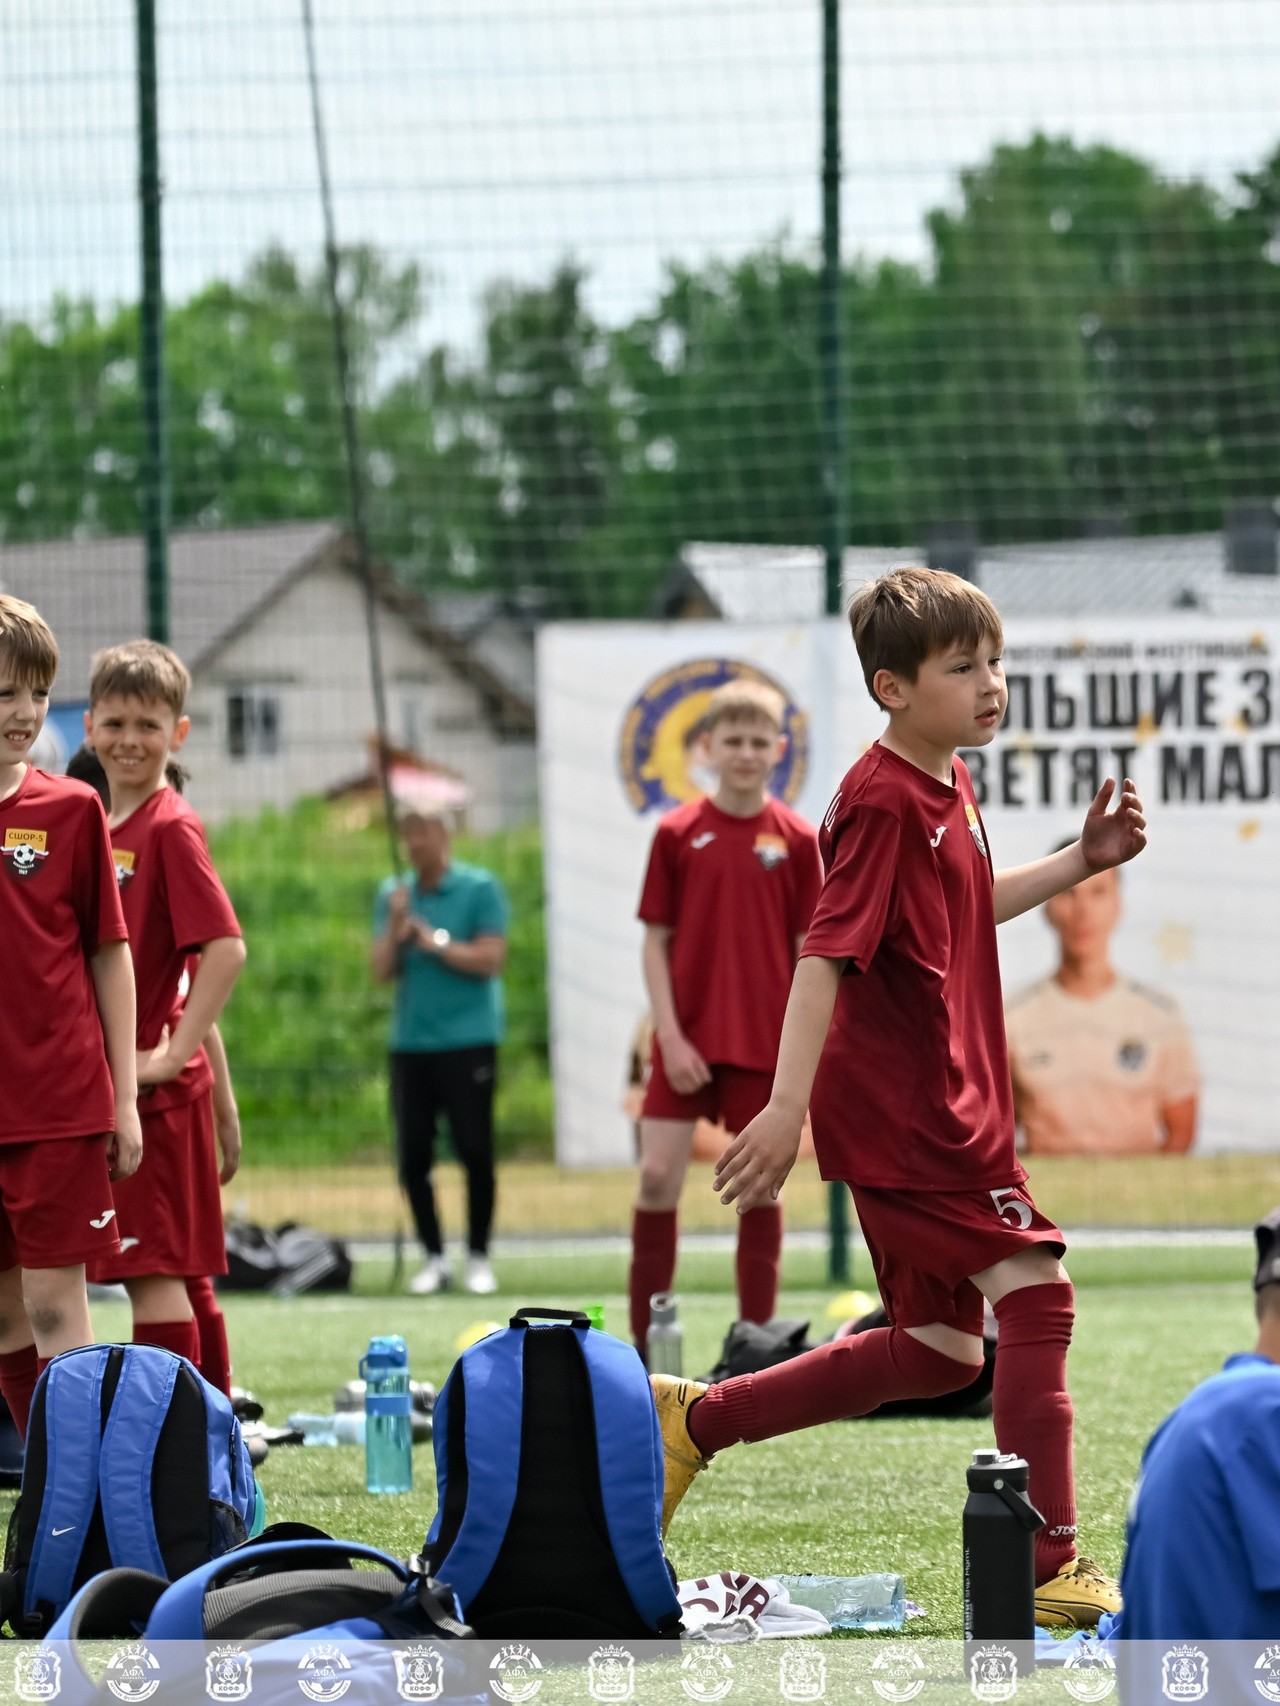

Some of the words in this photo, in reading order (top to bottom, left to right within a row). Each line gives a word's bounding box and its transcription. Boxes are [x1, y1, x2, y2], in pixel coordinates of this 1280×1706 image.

[1001, 668, 1217, 731] ЛЬШИЕ
[958, 744, 1137, 808] ВЕТЯТ
[8, 831, 44, 843] СШОР-5
[989, 1187, 1032, 1229] 5
